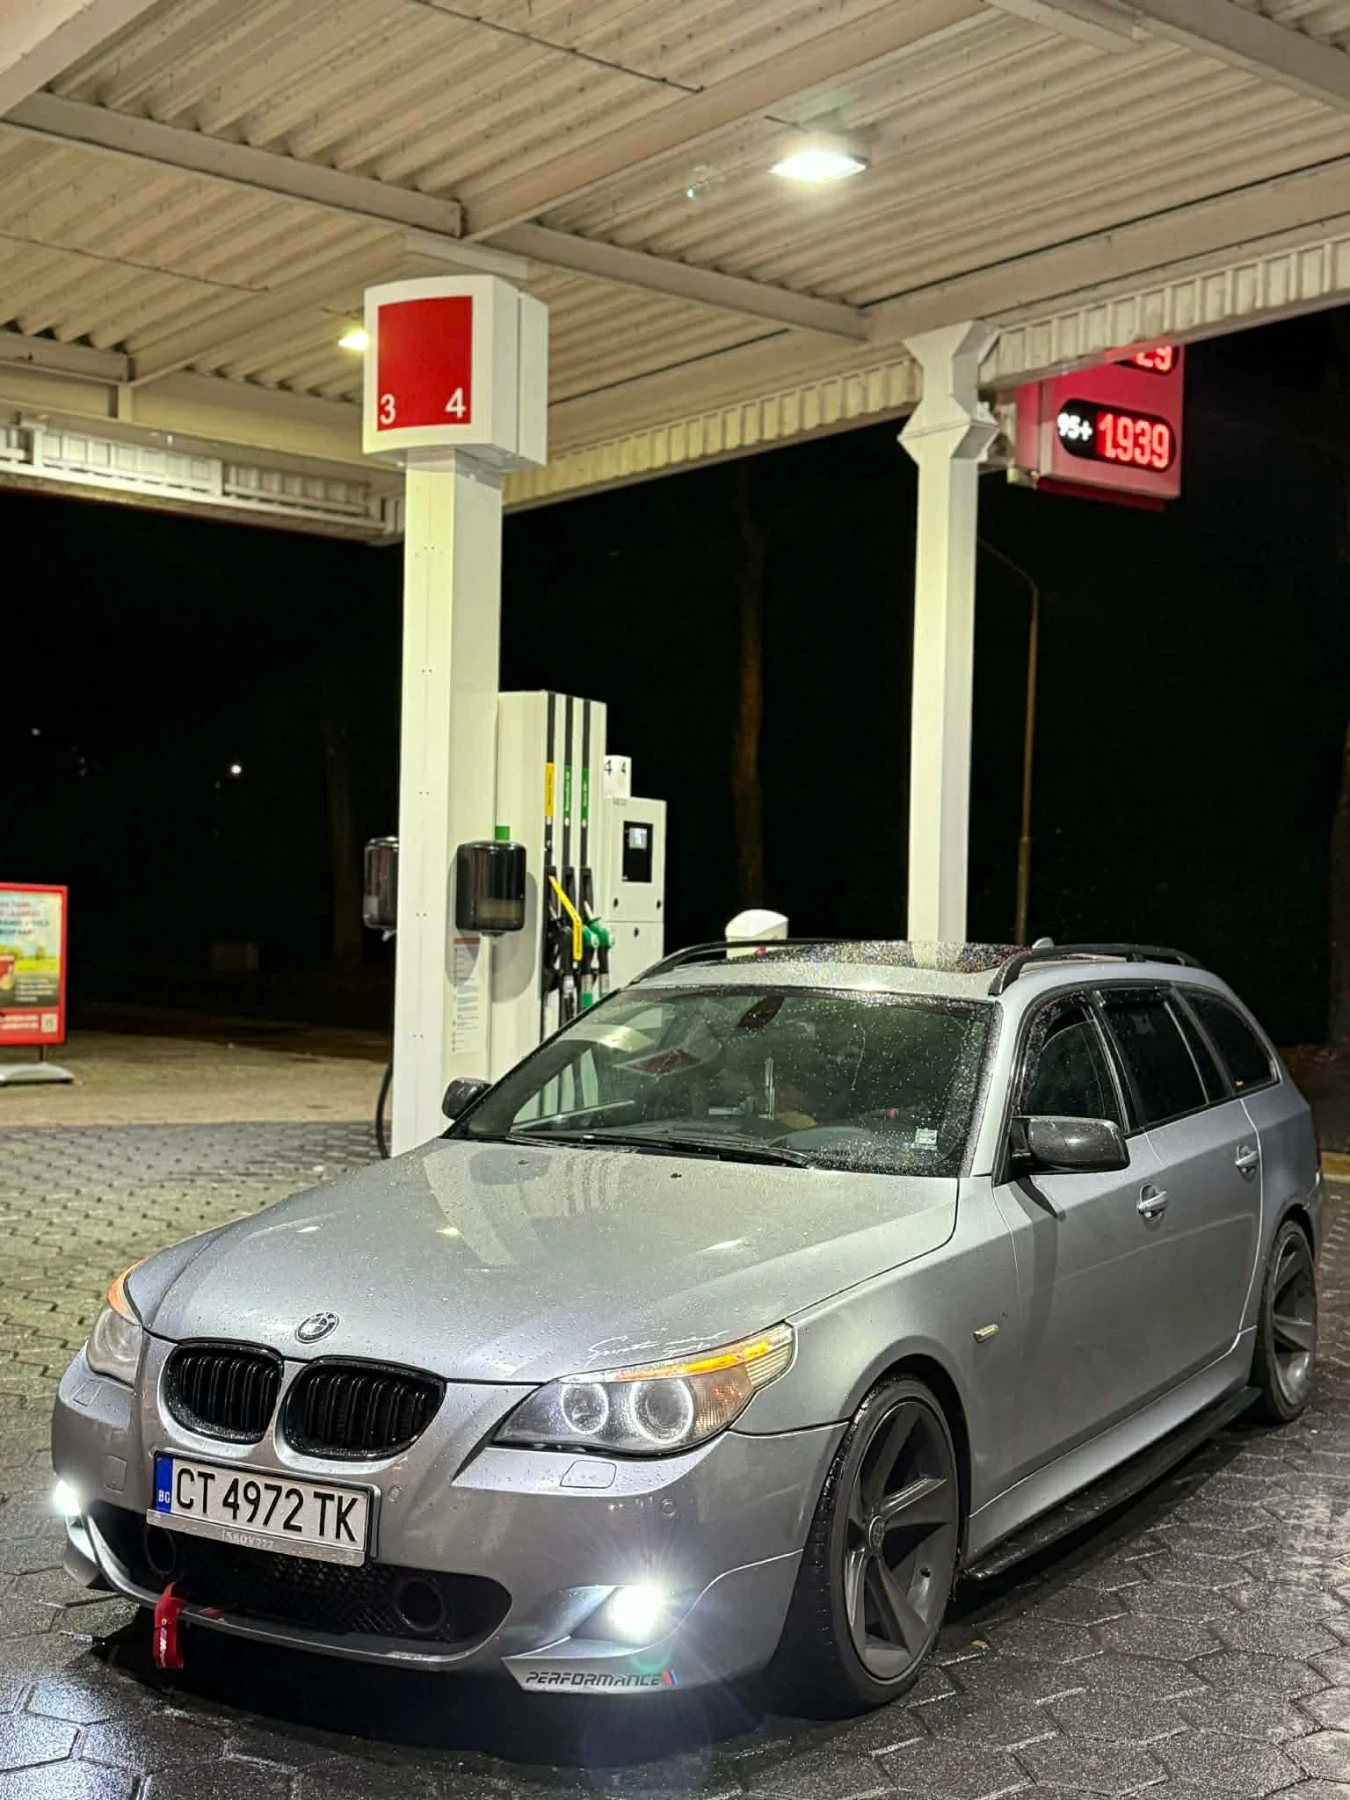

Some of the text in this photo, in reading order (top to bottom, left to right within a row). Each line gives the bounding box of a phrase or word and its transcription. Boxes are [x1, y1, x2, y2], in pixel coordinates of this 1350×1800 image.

[379, 386, 467, 425] 3 4
[1057, 412, 1093, 441] 95+
[604, 759, 613, 776] 4
[158, 1489, 171, 1504] BG
[176, 1467, 358, 1543] CT 4972 TK
[525, 1671, 661, 1686] PERFORMANCE
